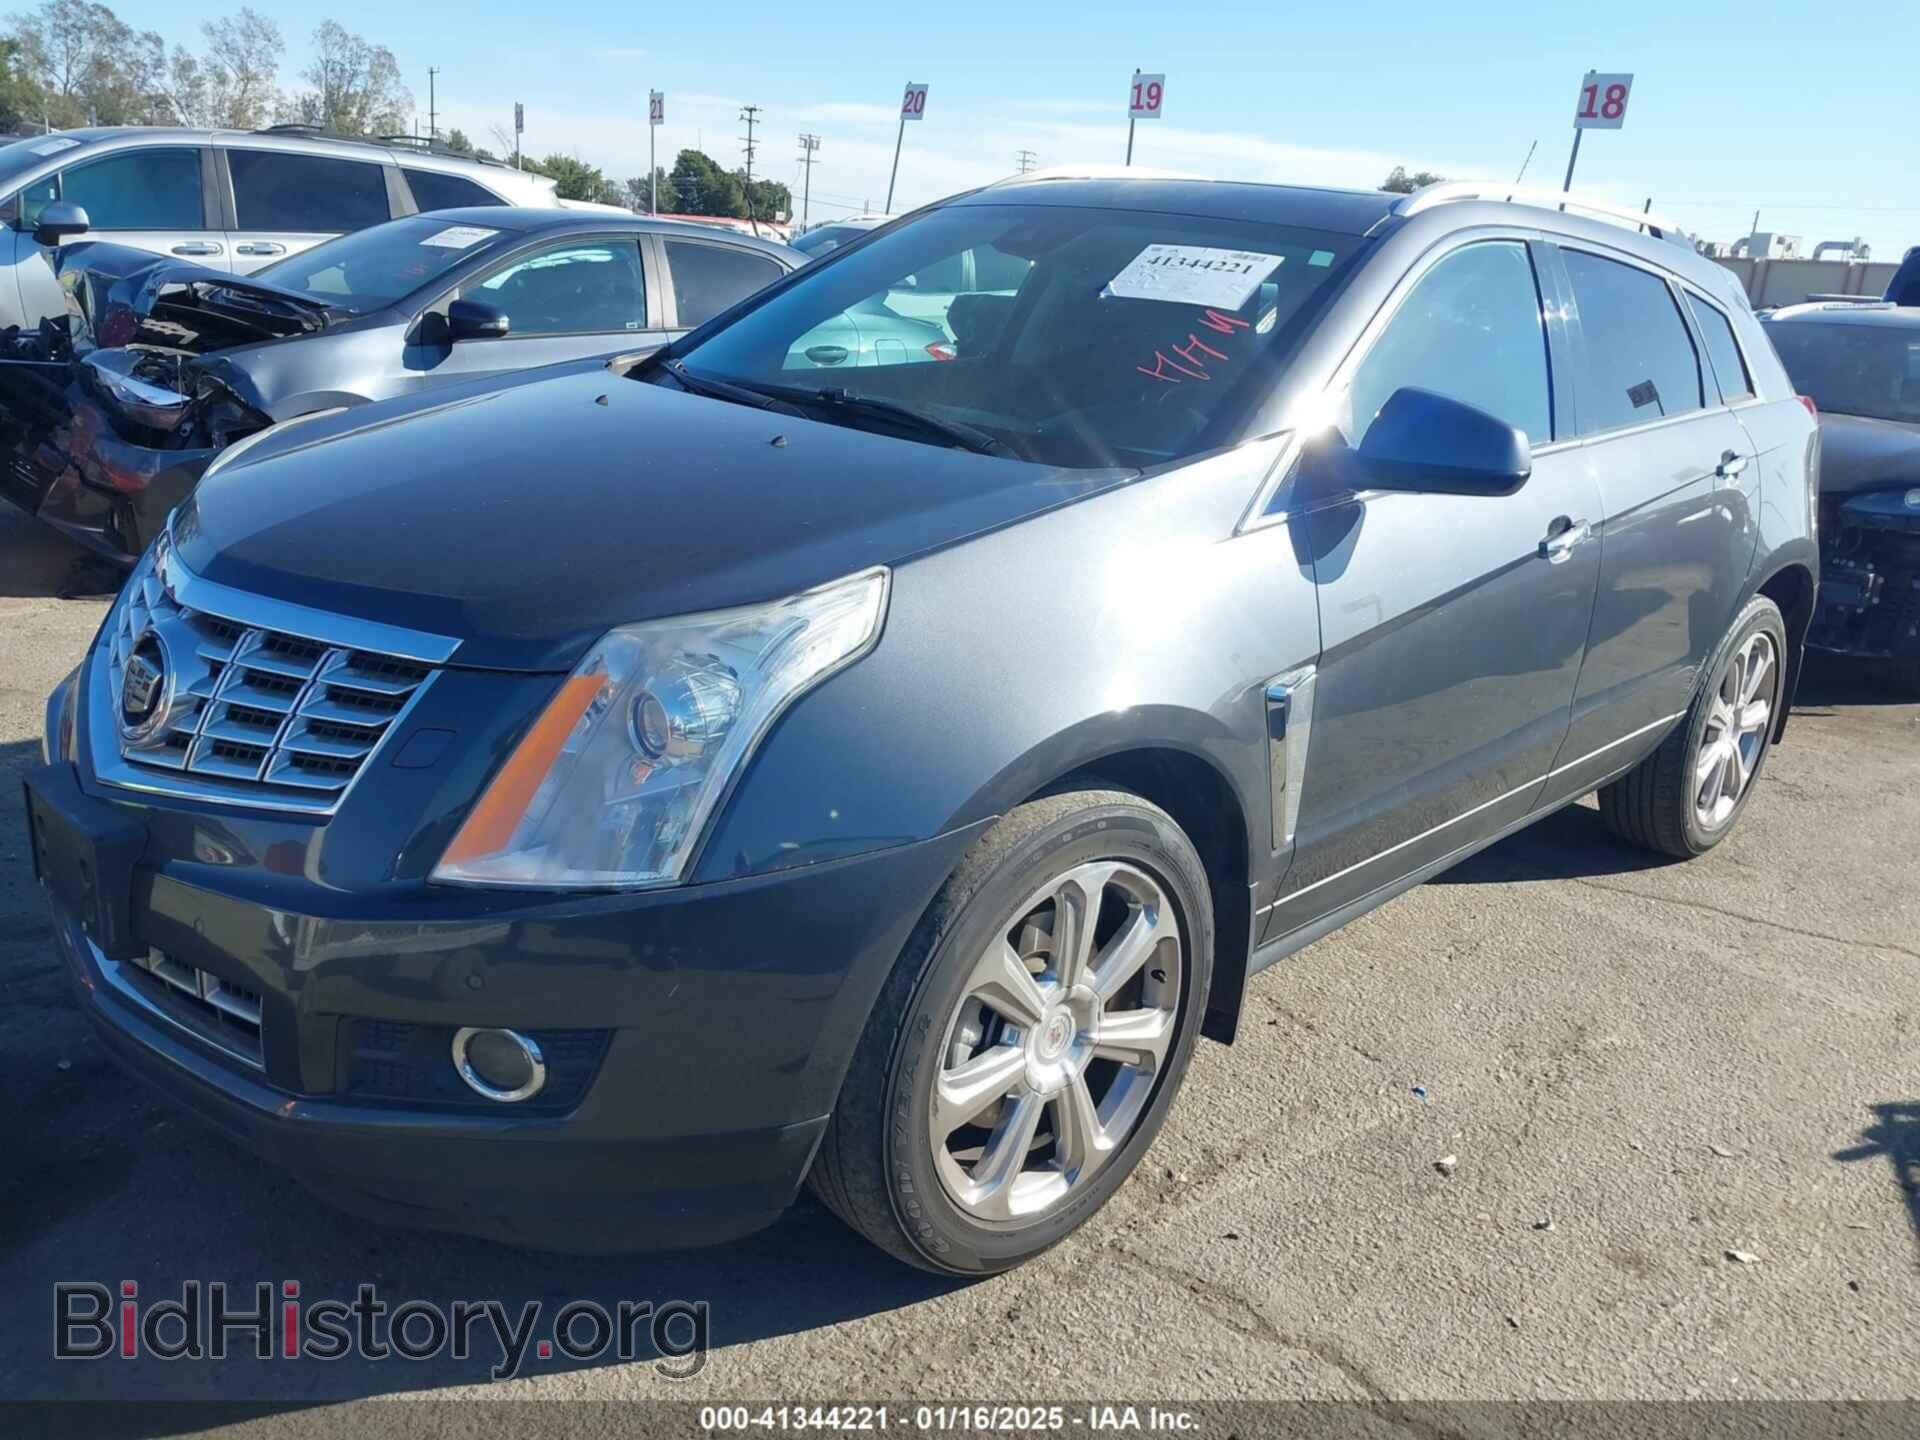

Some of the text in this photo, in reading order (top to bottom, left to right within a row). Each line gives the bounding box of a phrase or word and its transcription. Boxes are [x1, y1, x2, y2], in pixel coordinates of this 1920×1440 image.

[902, 90, 926, 114] 20
[1130, 82, 1162, 111] 19
[1578, 83, 1627, 120] 18
[650, 99, 664, 119] 21
[1146, 254, 1254, 275] 41344221
